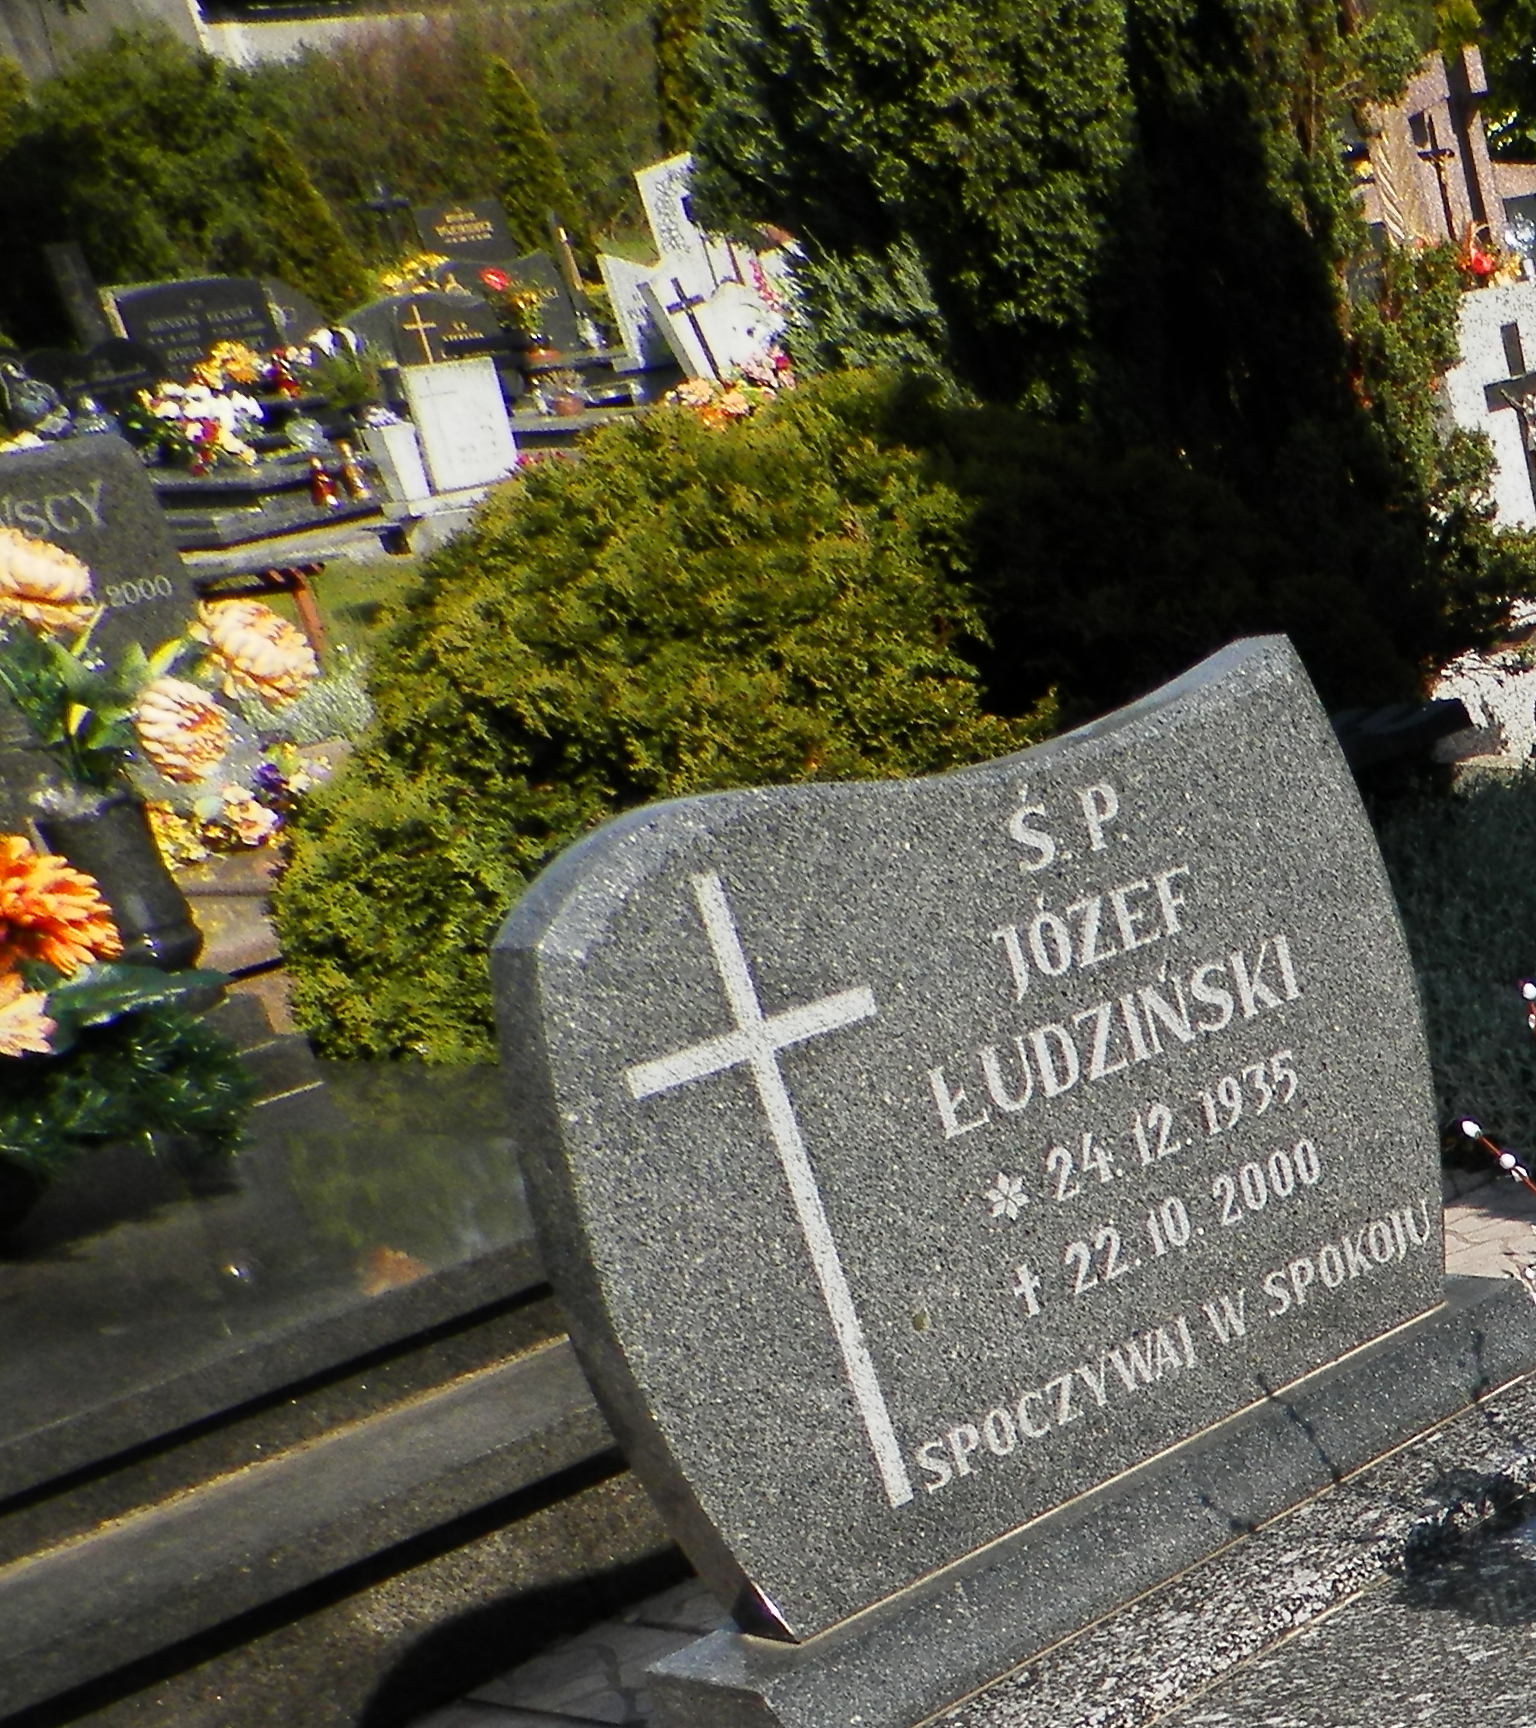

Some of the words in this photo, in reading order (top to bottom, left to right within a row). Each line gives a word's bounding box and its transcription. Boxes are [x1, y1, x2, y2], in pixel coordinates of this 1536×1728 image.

[992, 863, 1190, 1001] JÓZEF
[927, 933, 1302, 1140] ŁUDZIŃSKI
[915, 1314, 1197, 1494] SPOCZYWAJ
[1202, 1287, 1247, 1345] W
[1261, 1199, 1431, 1318] SPOKOJU
